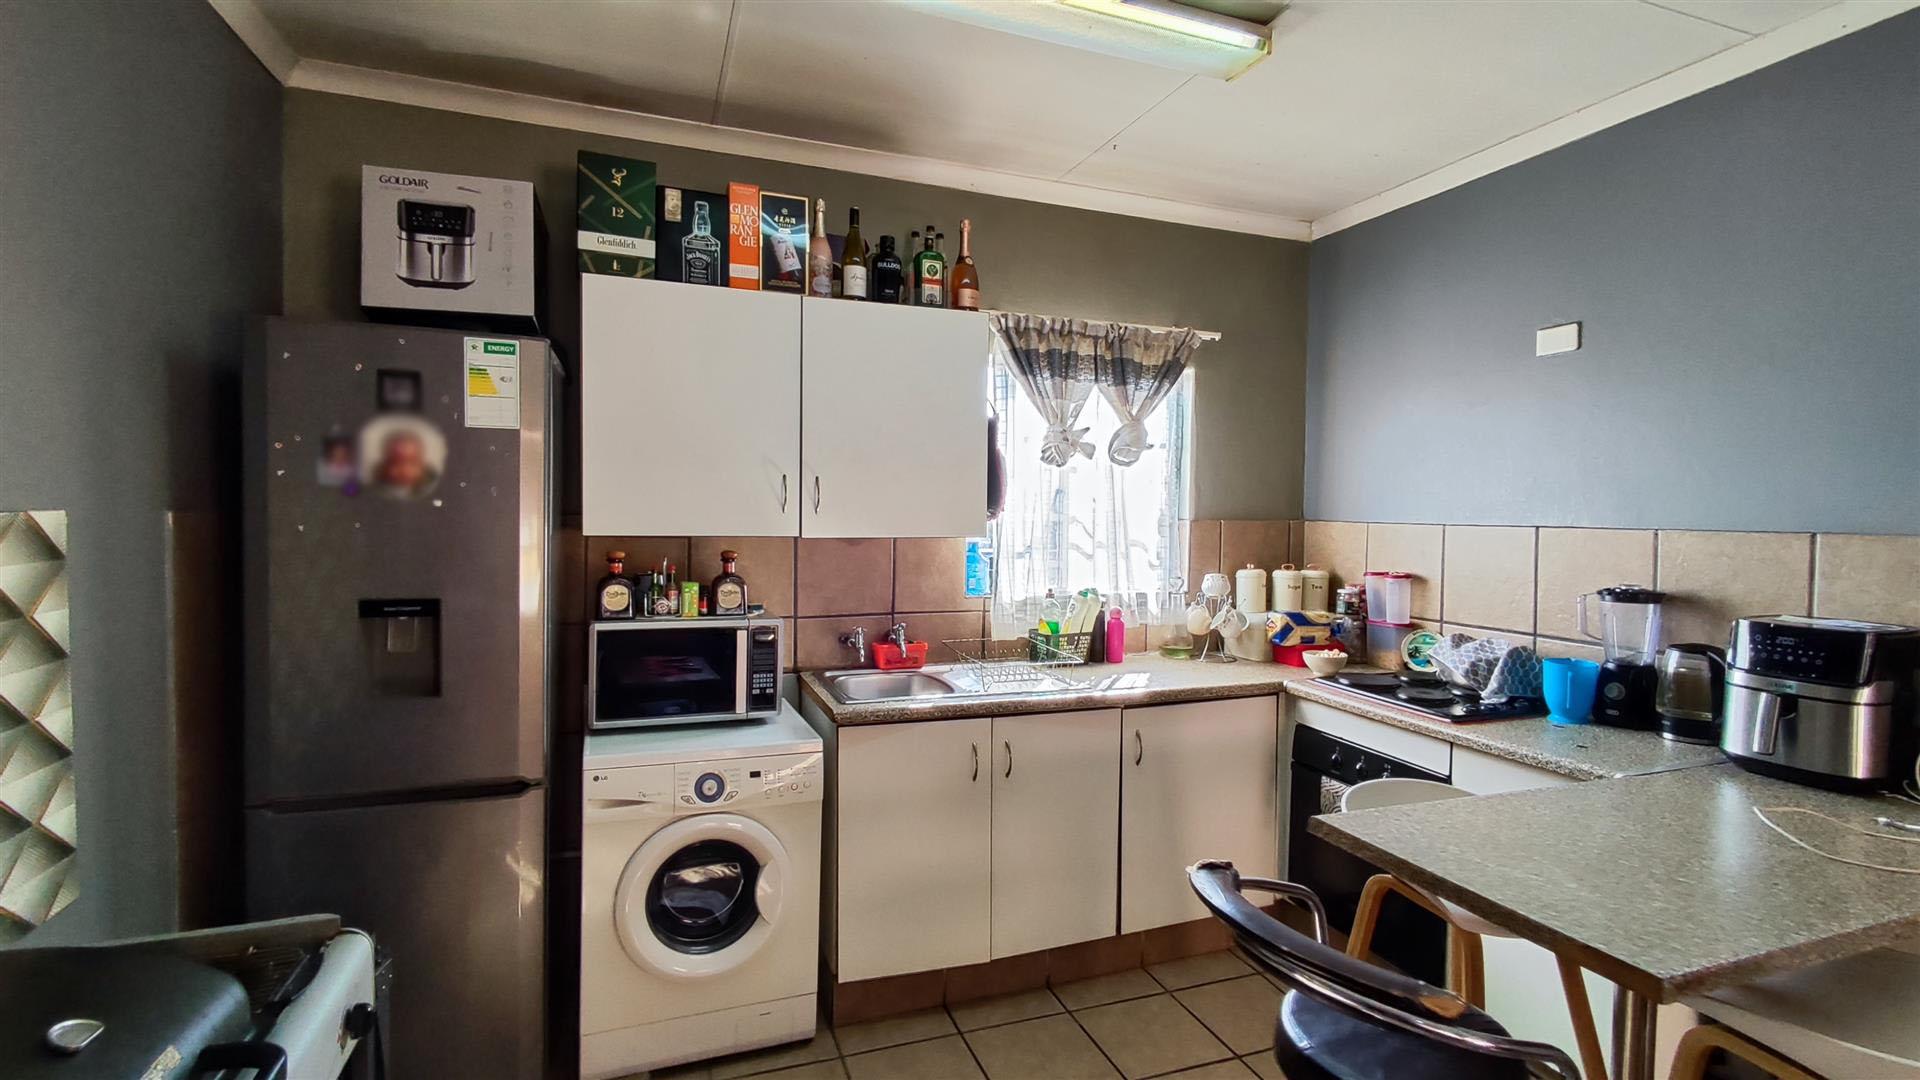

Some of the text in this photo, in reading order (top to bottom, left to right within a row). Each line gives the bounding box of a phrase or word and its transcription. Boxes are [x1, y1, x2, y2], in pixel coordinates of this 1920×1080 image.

[379, 174, 429, 190] GOLDAIR
[612, 206, 624, 218] 12
[730, 203, 758, 216] GLEN
[740, 215, 759, 227] MO
[730, 224, 753, 237] RAN
[596, 235, 637, 249] Glenfiddich
[739, 235, 757, 247] GIE
